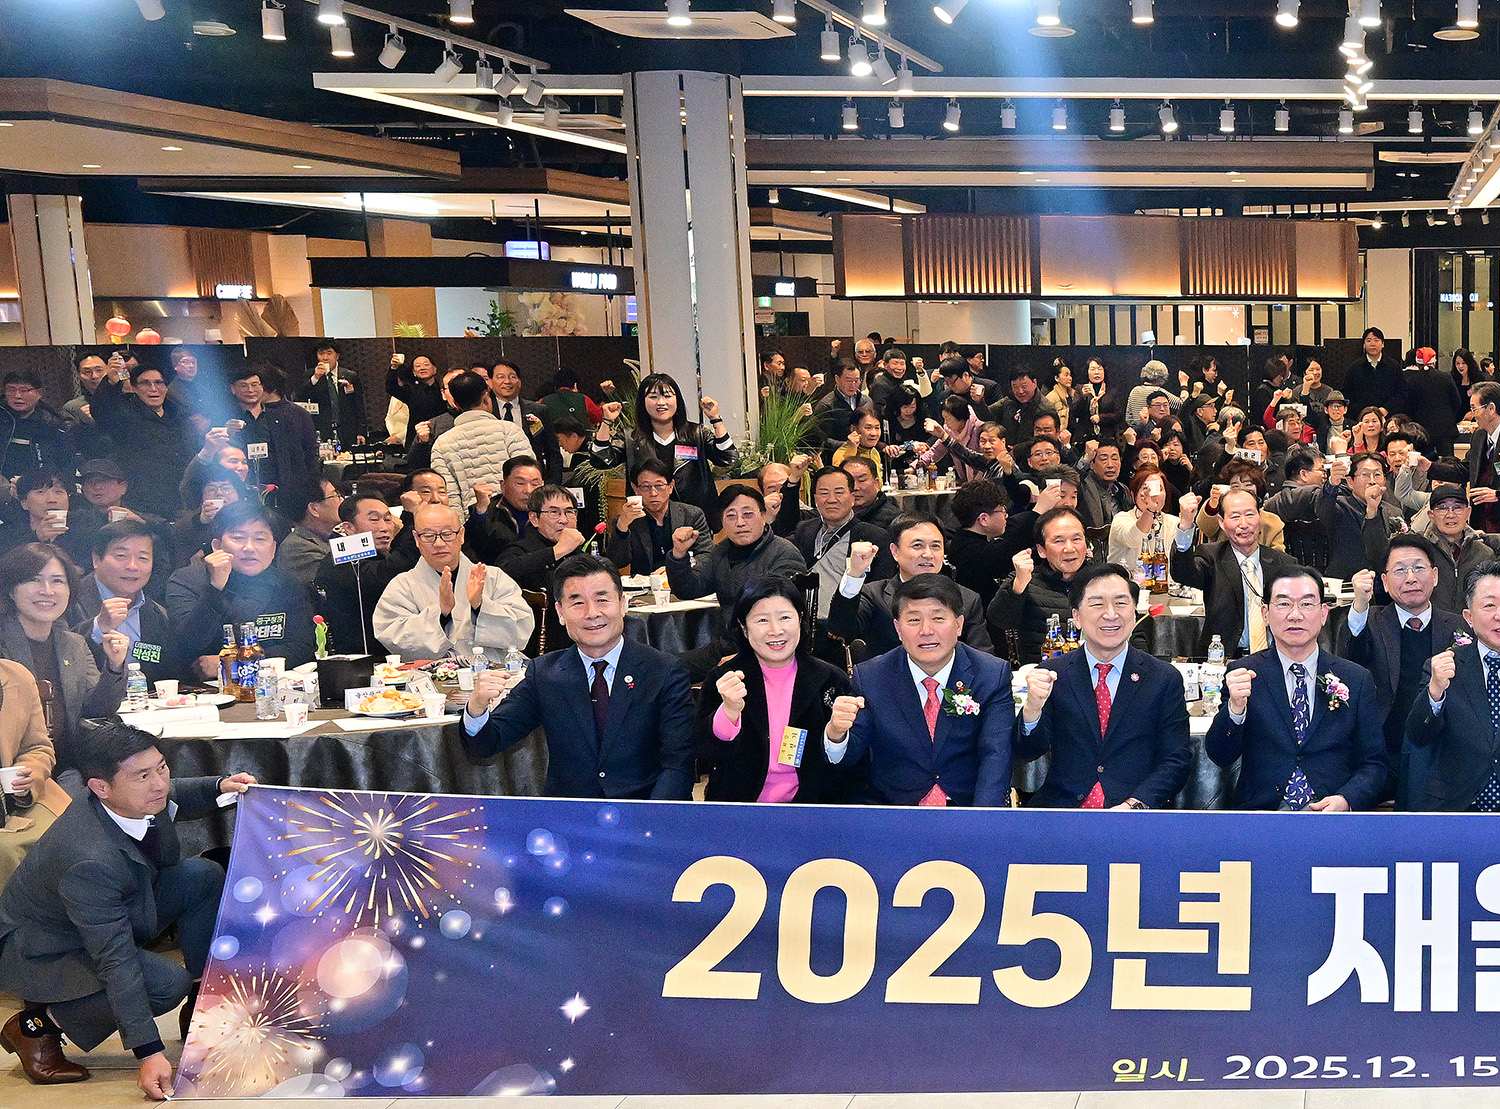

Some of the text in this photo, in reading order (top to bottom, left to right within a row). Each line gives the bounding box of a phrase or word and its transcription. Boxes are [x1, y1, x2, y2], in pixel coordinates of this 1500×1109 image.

[133, 647, 161, 663] 박성진
[661, 855, 1252, 1012] 2025년
[1223, 1056, 1430, 1081] 2025.12.
